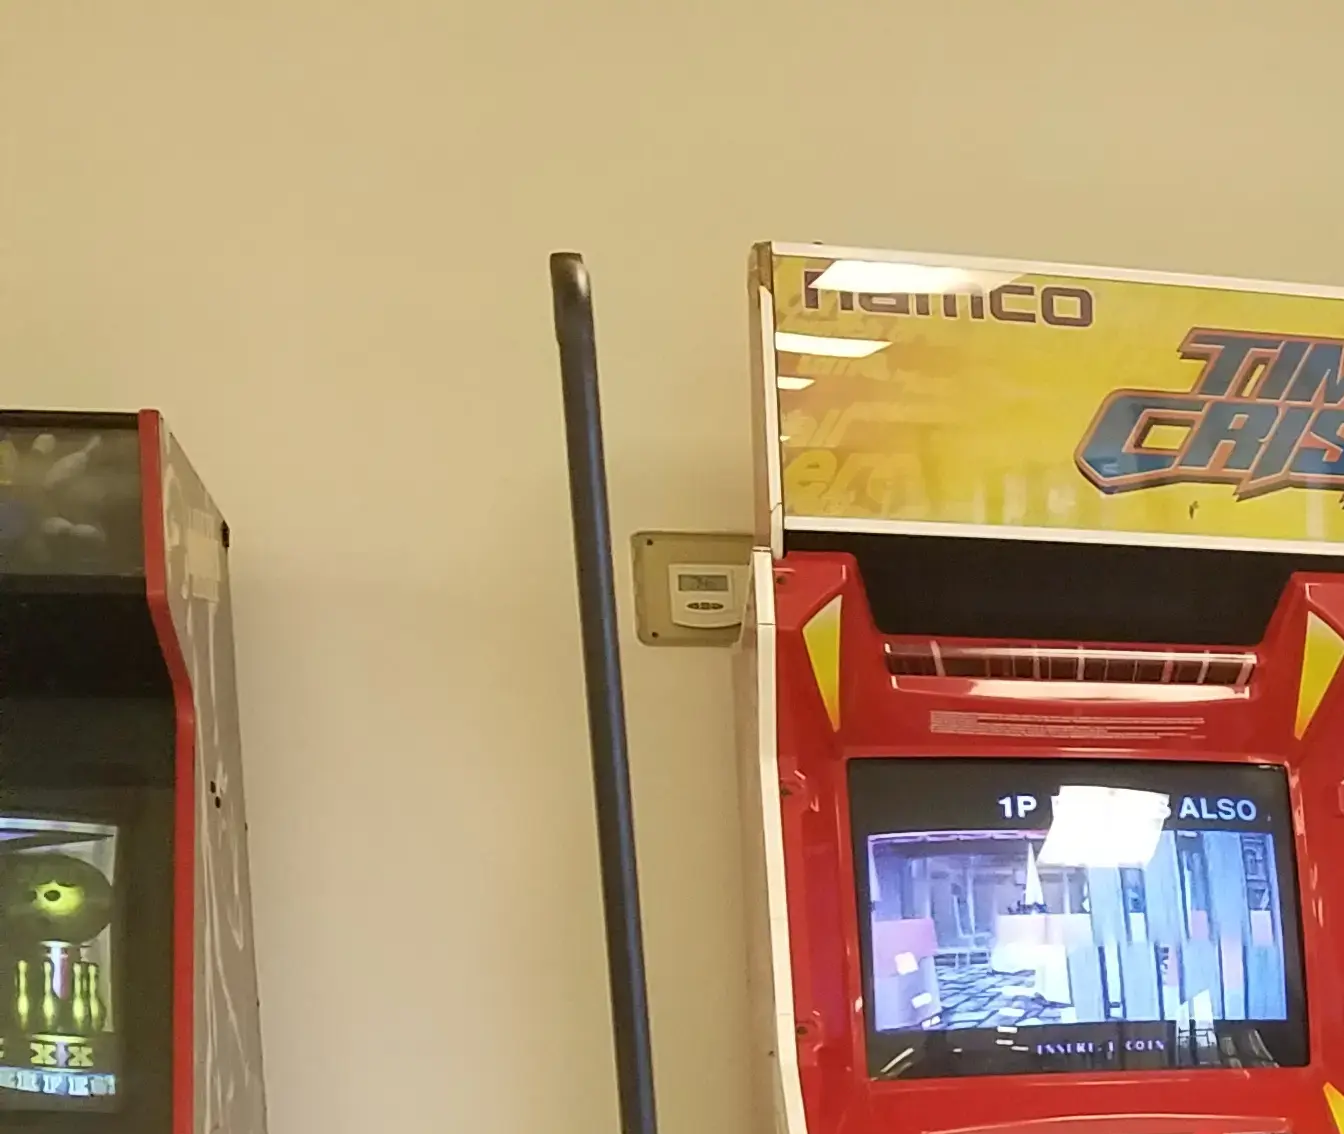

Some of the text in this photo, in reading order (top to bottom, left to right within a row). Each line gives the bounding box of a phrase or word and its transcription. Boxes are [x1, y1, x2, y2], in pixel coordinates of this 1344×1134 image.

[998, 795, 1038, 819] 1P
[1179, 797, 1258, 821] ALSO
[1125, 1040, 1165, 1051] COIN
